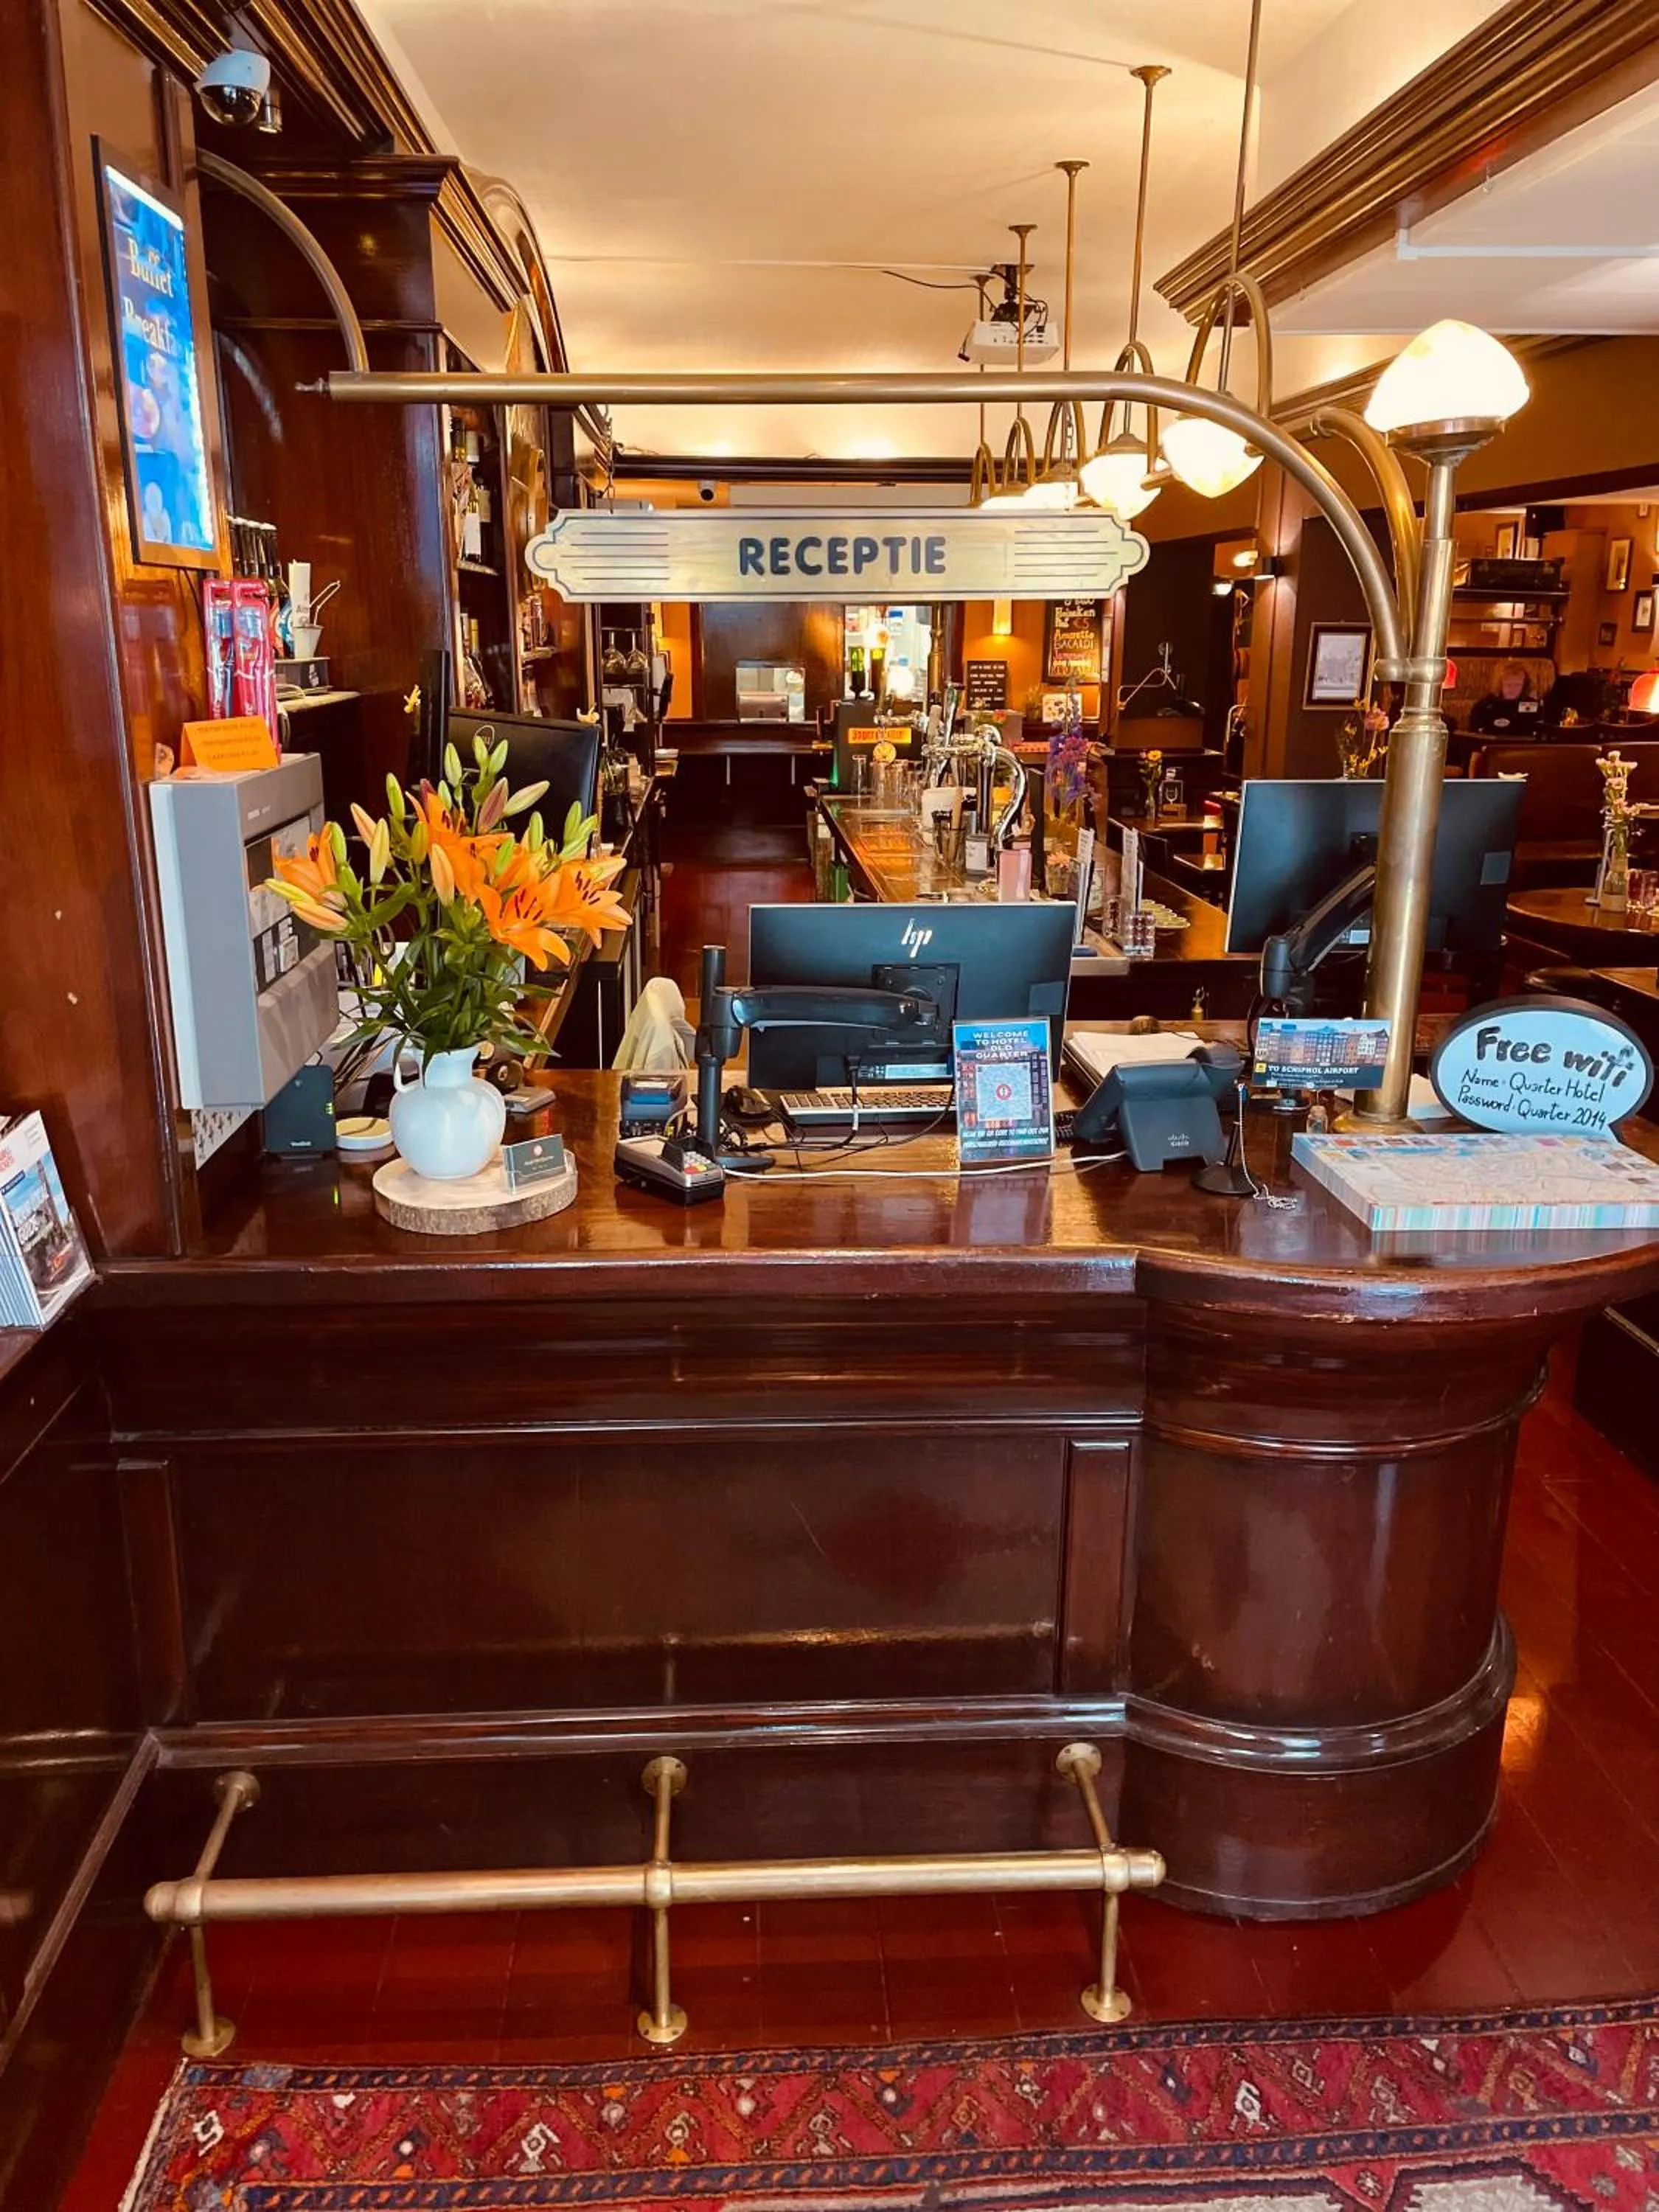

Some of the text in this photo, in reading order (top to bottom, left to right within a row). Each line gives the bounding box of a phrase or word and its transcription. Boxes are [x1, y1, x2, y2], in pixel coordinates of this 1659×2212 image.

[127, 237, 174, 298] Buffet
[739, 536, 946, 576] RECEPTIE
[901, 917, 933, 959] hp
[973, 1031, 1029, 1039] WELCOME
[1476, 1026, 1552, 1063] Free
[975, 1051, 1029, 1060] QUARTER
[1281, 1065, 1324, 1074] SCHIPHOL
[1509, 1071, 1562, 1096] Quarter
[1565, 1079, 1606, 1104] Hotel
[1517, 1099, 1571, 1122] Quarter
[1571, 1107, 1607, 1130] 2014
